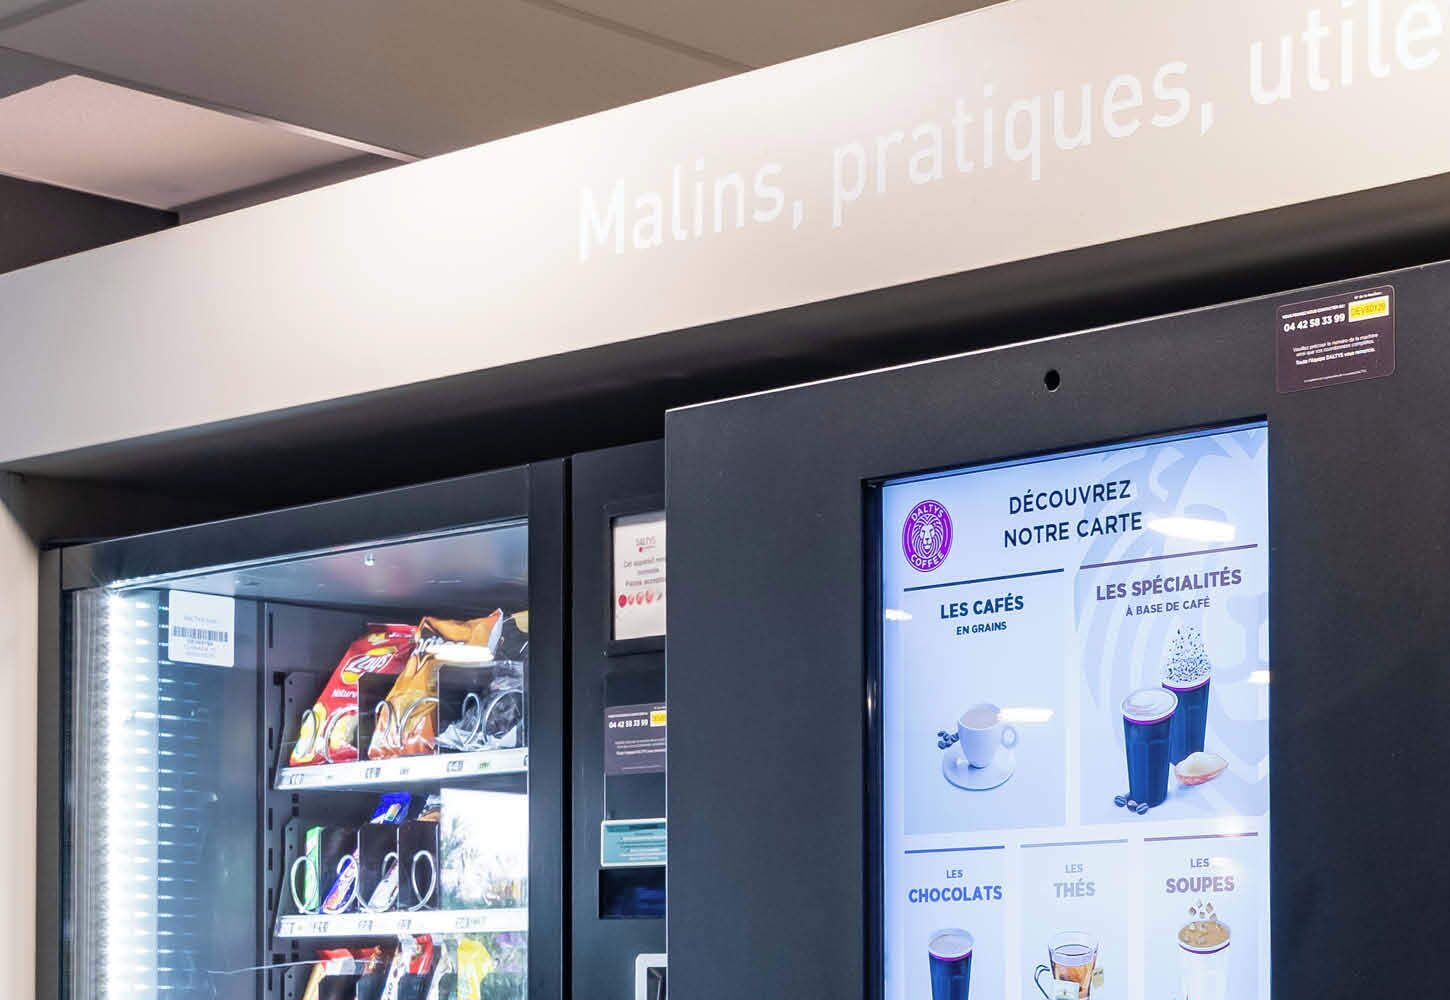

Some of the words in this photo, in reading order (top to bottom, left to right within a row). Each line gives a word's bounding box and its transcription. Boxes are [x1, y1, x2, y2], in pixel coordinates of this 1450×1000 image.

[578, 158, 804, 262] Malins,
[832, 57, 1216, 226] pratiques,
[1284, 322, 1295, 332] 04
[1297, 320, 1308, 329] 42
[1310, 317, 1320, 327] 58
[1322, 315, 1332, 325] 33
[1334, 313, 1345, 323] 99
[1009, 479, 1131, 515] DÉCOUVREZ
[911, 504, 944, 521] DALTYS
[1004, 521, 1070, 548] NOTRE
[1077, 512, 1143, 539] CARTE
[911, 553, 944, 568] COFFEE
[1096, 581, 1127, 601] LES
[1131, 568, 1242, 597] SPÉCIALITÉS
[940, 602, 969, 620] LES
[972, 593, 1025, 615] CAFÉS
[1125, 604, 1134, 617] À
[1135, 602, 1164, 616] BASE
[1166, 601, 1180, 613] DE
[1182, 596, 1211, 612] CAFÉ
[956, 625, 970, 635] EN
[971, 621, 1007, 634] GRAINS
[1065, 863, 1084, 874] LES
[1190, 857, 1210, 868] LES
[946, 868, 964, 880] LES
[908, 885, 1003, 904] CHOCOLATS
[1053, 877, 1096, 899] THÉS
[1165, 876, 1235, 894] SOUPES
